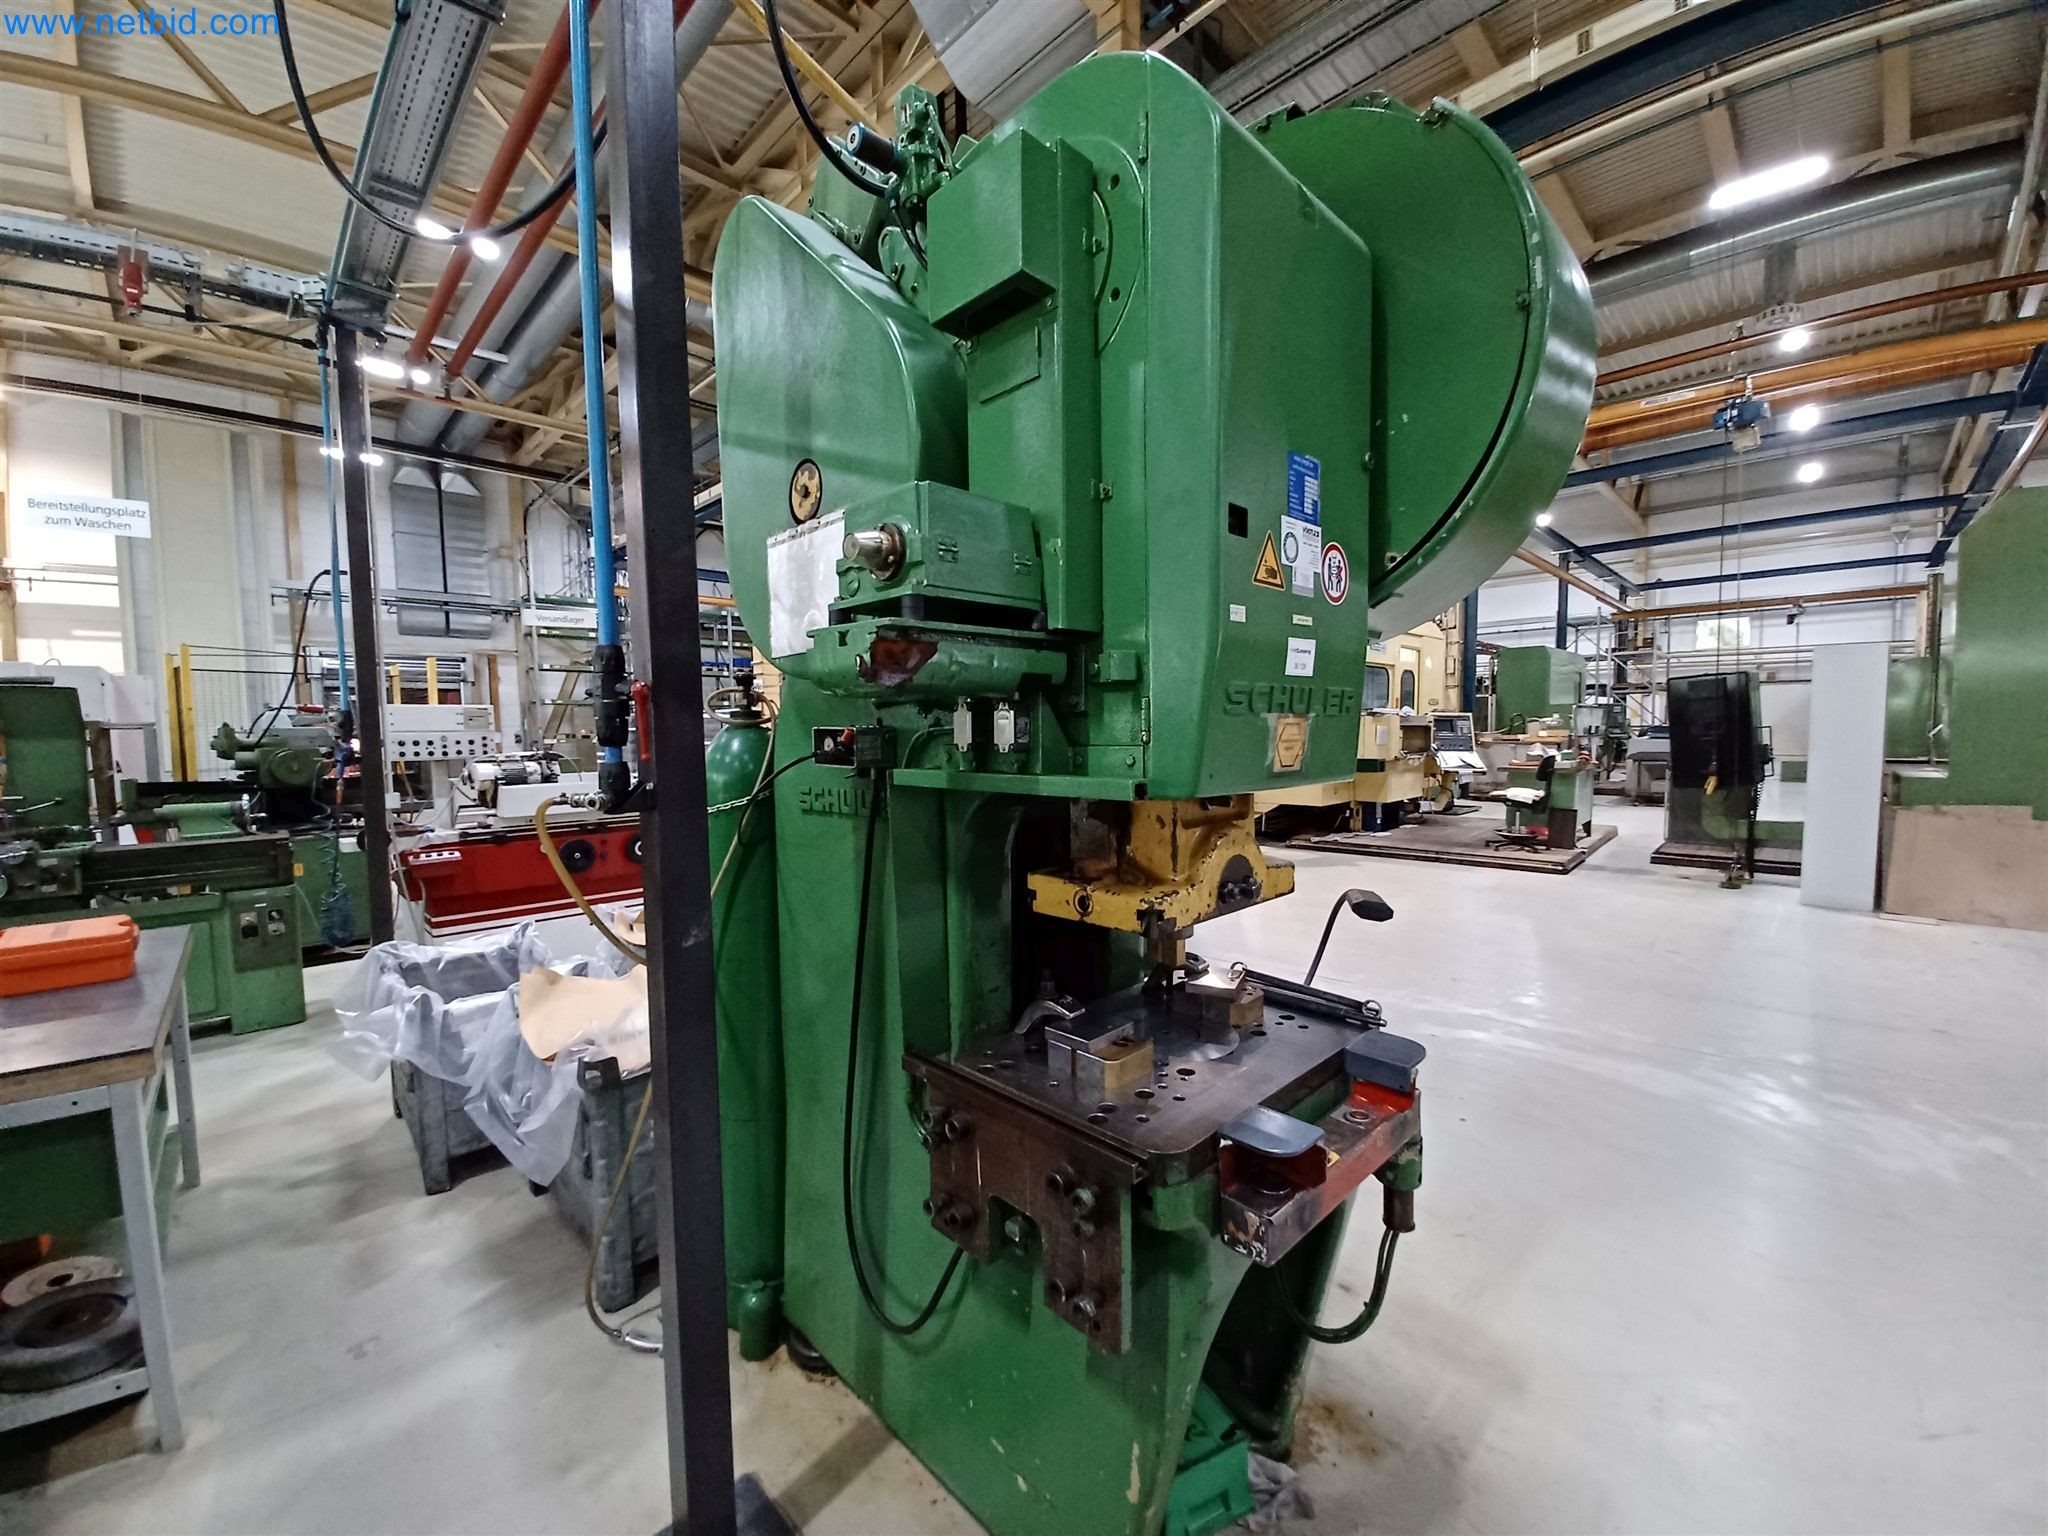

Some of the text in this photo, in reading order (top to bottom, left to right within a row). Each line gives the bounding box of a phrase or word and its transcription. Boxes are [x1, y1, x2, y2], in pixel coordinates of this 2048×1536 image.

[27, 498, 146, 518] Bereitstellungsplatz
[44, 516, 132, 530] zum Waschen
[536, 615, 585, 625] Versandlager
[1225, 682, 1356, 716] SCHULER
